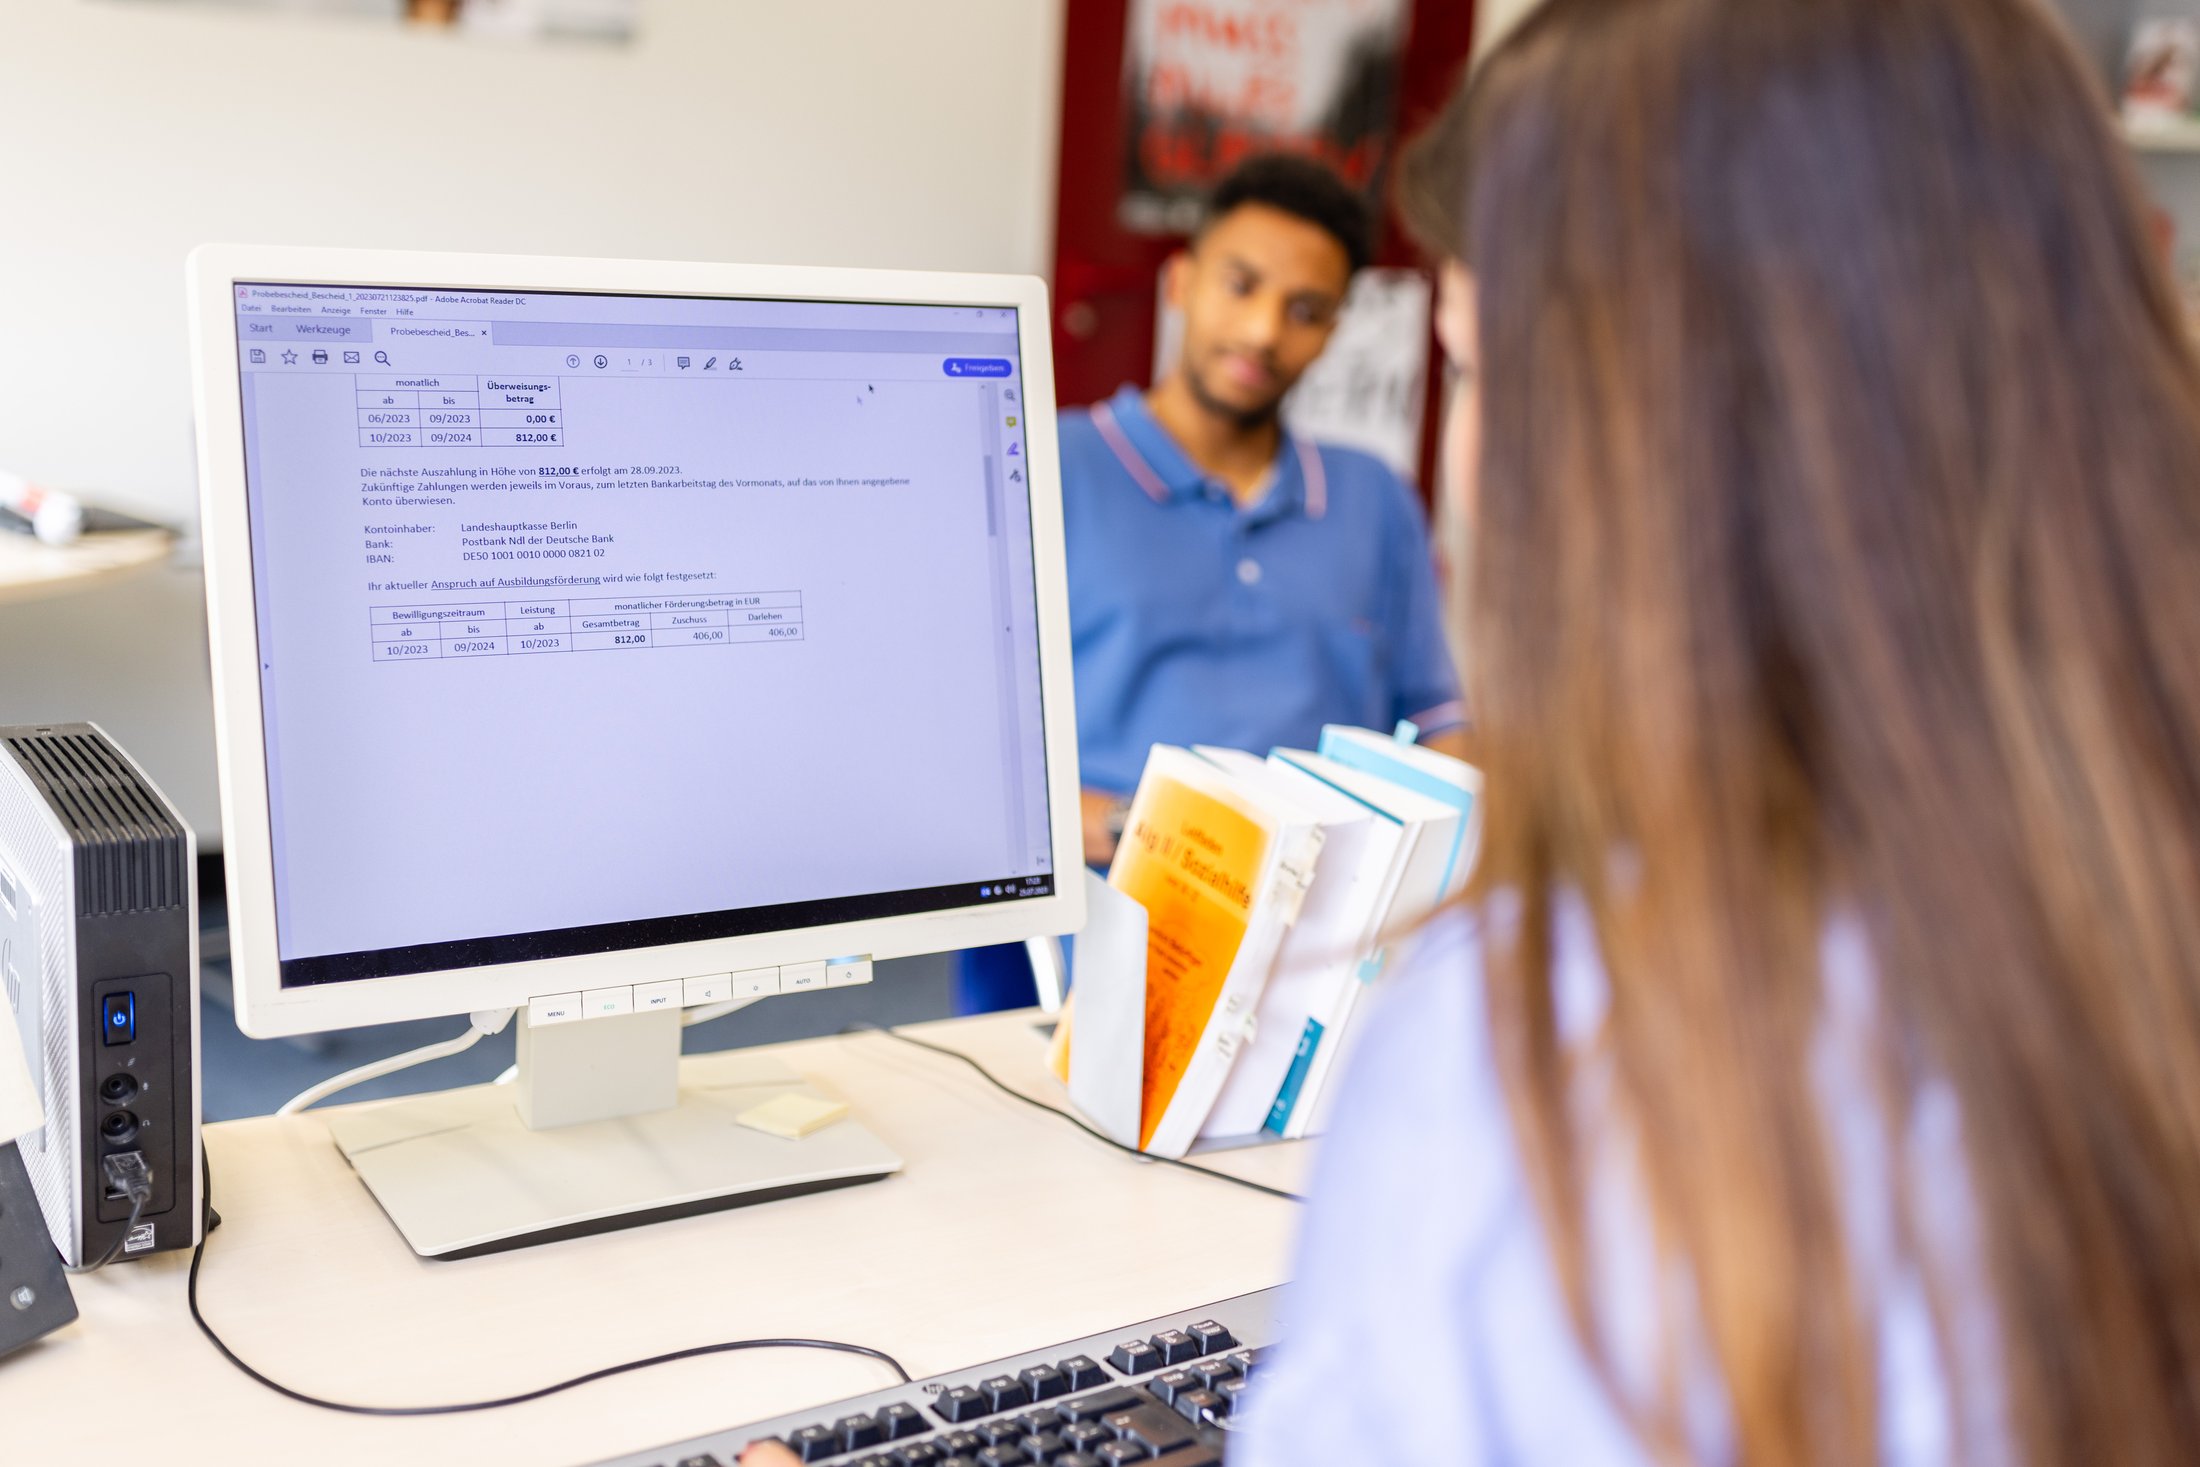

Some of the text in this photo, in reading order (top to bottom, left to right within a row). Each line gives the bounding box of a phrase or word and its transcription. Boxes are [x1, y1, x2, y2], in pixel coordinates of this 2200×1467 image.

[435, 296, 459, 304] Adobe
[461, 296, 489, 305] Acrobat
[490, 297, 514, 305] Reader
[515, 297, 527, 306] DC
[241, 304, 414, 316] Datei Bearbeiten Anzeige Fenster Hilfe
[249, 323, 475, 338] Start Werkzeuge Probebescheid_Bes...
[395, 378, 440, 387] monatlich
[487, 381, 552, 392] Überweisungs-
[382, 396, 394, 405] ab
[443, 396, 456, 405] bis
[505, 394, 534, 404] betrag
[368, 414, 411, 424] 06/2023
[429, 413, 471, 424] 09/2023
[526, 414, 556, 424] 0,00 €
[369, 433, 412, 443] 10/2023
[430, 433, 472, 443] 09/2024
[515, 433, 557, 444] 812,00 €
[361, 468, 377, 478] Die
[380, 468, 419, 478] nächste
[421, 467, 477, 479] Auszahlung
[479, 468, 488, 477] in
[490, 466, 516, 476] Höhe
[538, 466, 570, 477] 812,00
[572, 467, 579, 476] €
[581, 466, 611, 478] erfolgt
[630, 466, 683, 475] 28.09.2023.
[361, 482, 415, 493] Zukünftige
[417, 481, 468, 493] Zahlungen
[470, 482, 508, 491] werden
[509, 481, 542, 492] jeweils
[544, 482, 556, 490] im
[558, 481, 594, 491] Voraus,
[596, 482, 615, 490] zum
[617, 480, 649, 490] letzten
[651, 479, 716, 490] Bankarbeitstag
[718, 479, 734, 488] des
[736, 479, 785, 489] Vormonats,
[787, 478, 801, 486] auf
[802, 478, 817, 486] das
[836, 478, 860, 486] Ihnen
[861, 477, 910, 488] angegebene
[362, 496, 456, 506] Konto überwiesen.
[364, 521, 578, 534] Kontoinhaber: Landeshauptkasse Berlin
[365, 534, 614, 549] Bank: Postbank Ndl der Deutsche Bank
[366, 549, 605, 564] IBAN: DE50 1001 0010 0000 0821 02
[368, 571, 717, 591] Ihr aktueller Anspruch auf Ausbildungsförderung wird wie folgt festgesetzt:
[614, 601, 662, 611] monatlicher
[664, 598, 734, 609] Förderungsbetrag
[392, 609, 485, 621] Bewilligungszeitraum
[520, 606, 556, 616] Leistung
[672, 615, 707, 625] Zuschuss
[748, 613, 782, 622] Darlehen
[533, 623, 545, 631] ab
[582, 619, 640, 629] Gesamtbetrag
[401, 629, 412, 637] ab
[467, 625, 480, 634] bis
[768, 628, 798, 637] 406,00
[615, 635, 645, 645] 812,00
[692, 631, 723, 641] 406,00
[454, 642, 495, 652] 09/2024
[520, 639, 560, 649] 10/2023
[387, 645, 428, 656] 10/2023
[651, 997, 666, 1005] INPUT
